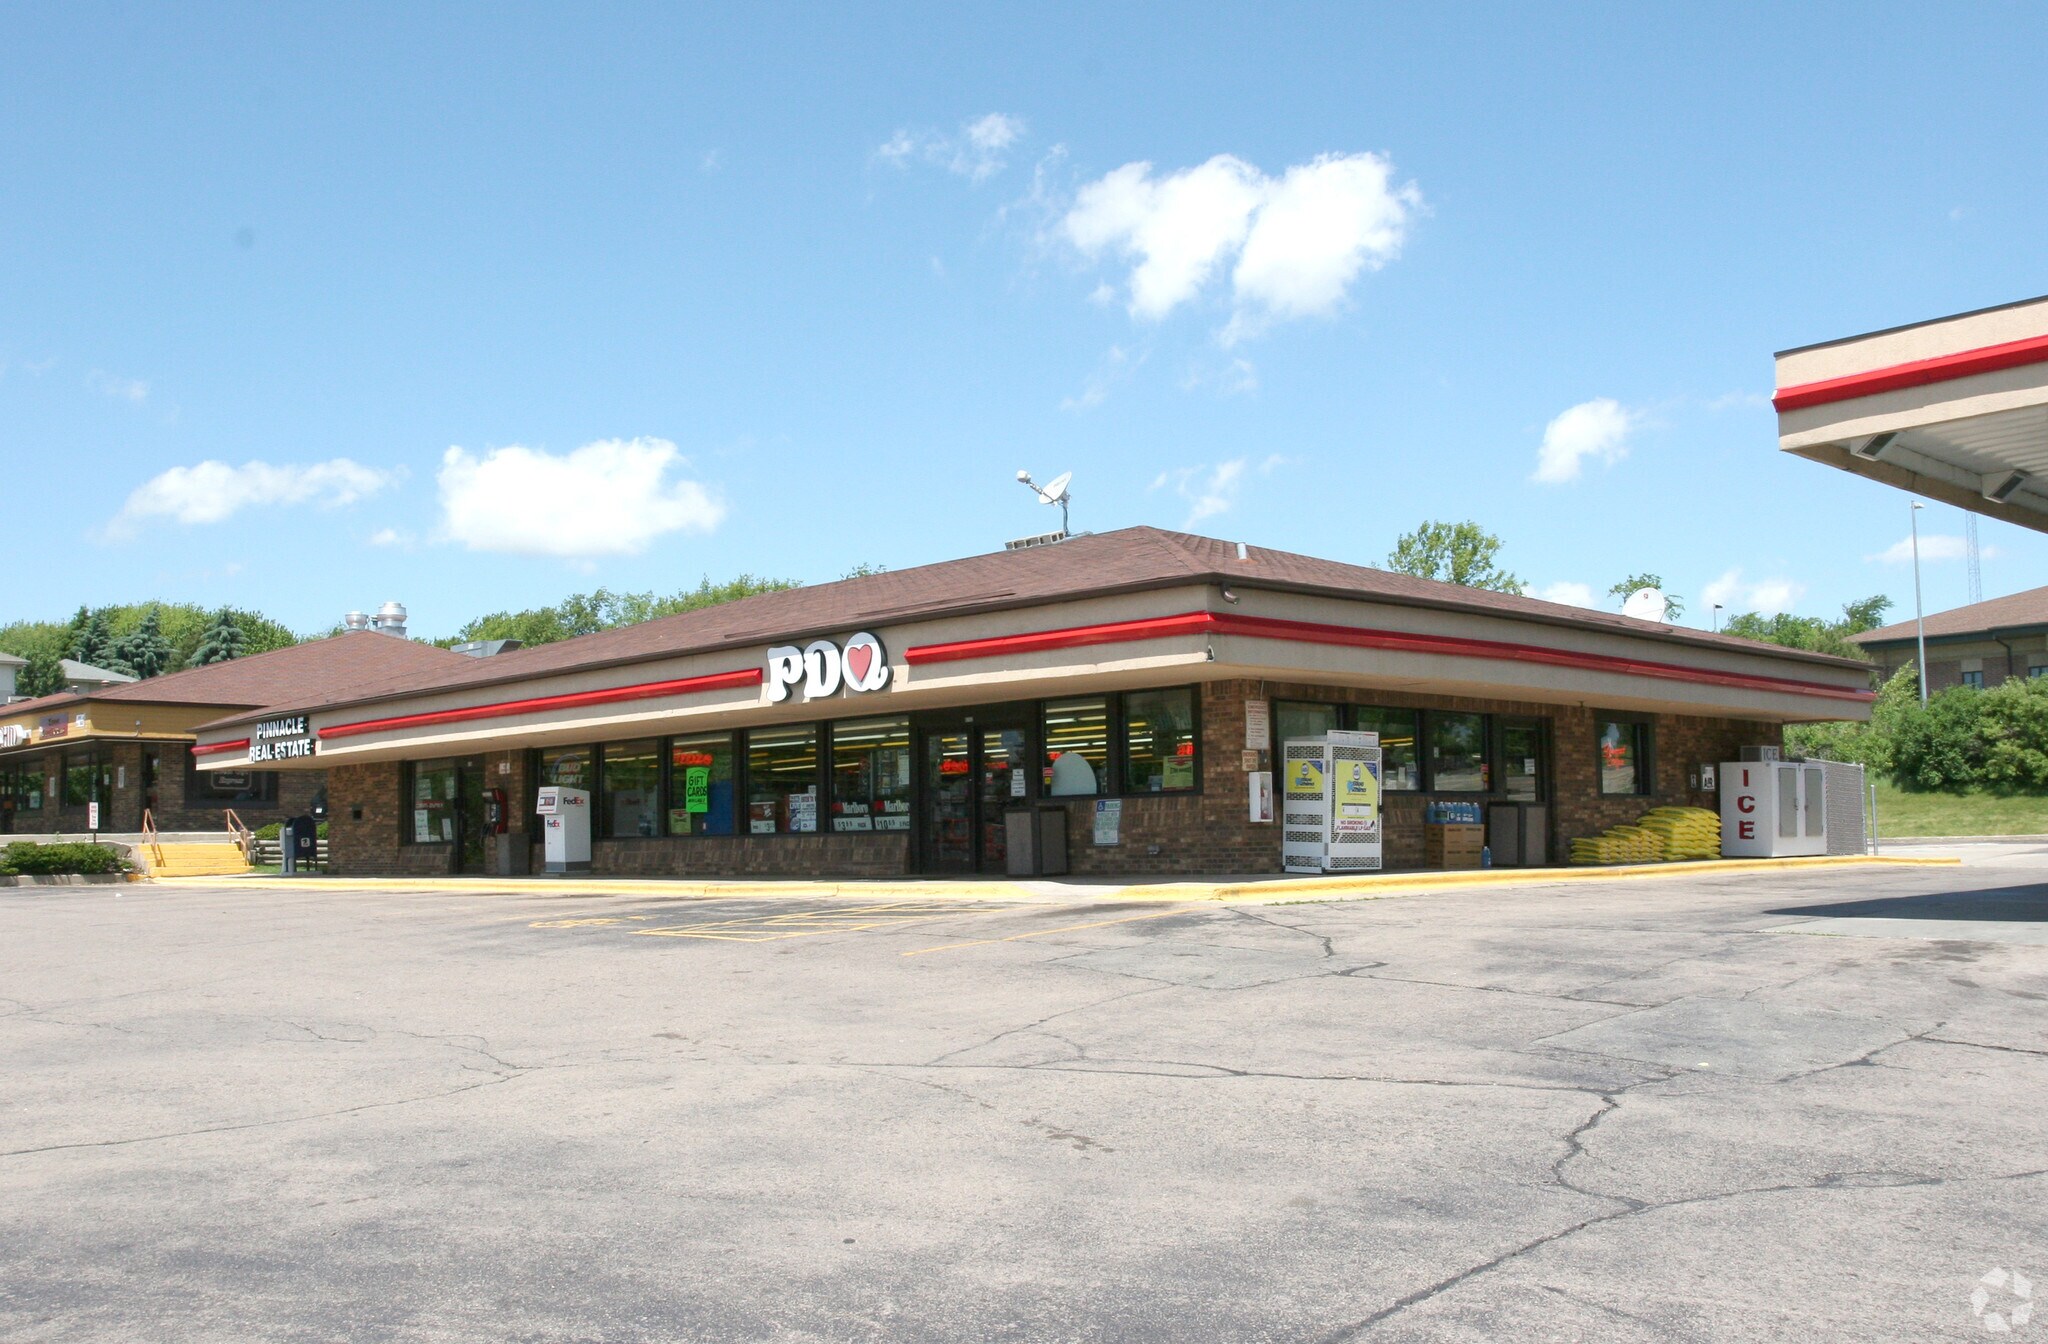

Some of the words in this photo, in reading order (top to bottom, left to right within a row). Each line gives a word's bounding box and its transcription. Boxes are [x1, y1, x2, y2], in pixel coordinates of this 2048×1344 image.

[767, 632, 889, 702] PDQ
[256, 716, 304, 739] PINNACLE
[249, 744, 273, 762] REAL
[274, 739, 311, 759] ESTATE
[1762, 748, 1778, 760] ICE
[688, 775, 704, 786] GIFT
[687, 786, 707, 797] CARDS
[563, 797, 585, 805] FedEx
[1737, 769, 1756, 839] ICE
